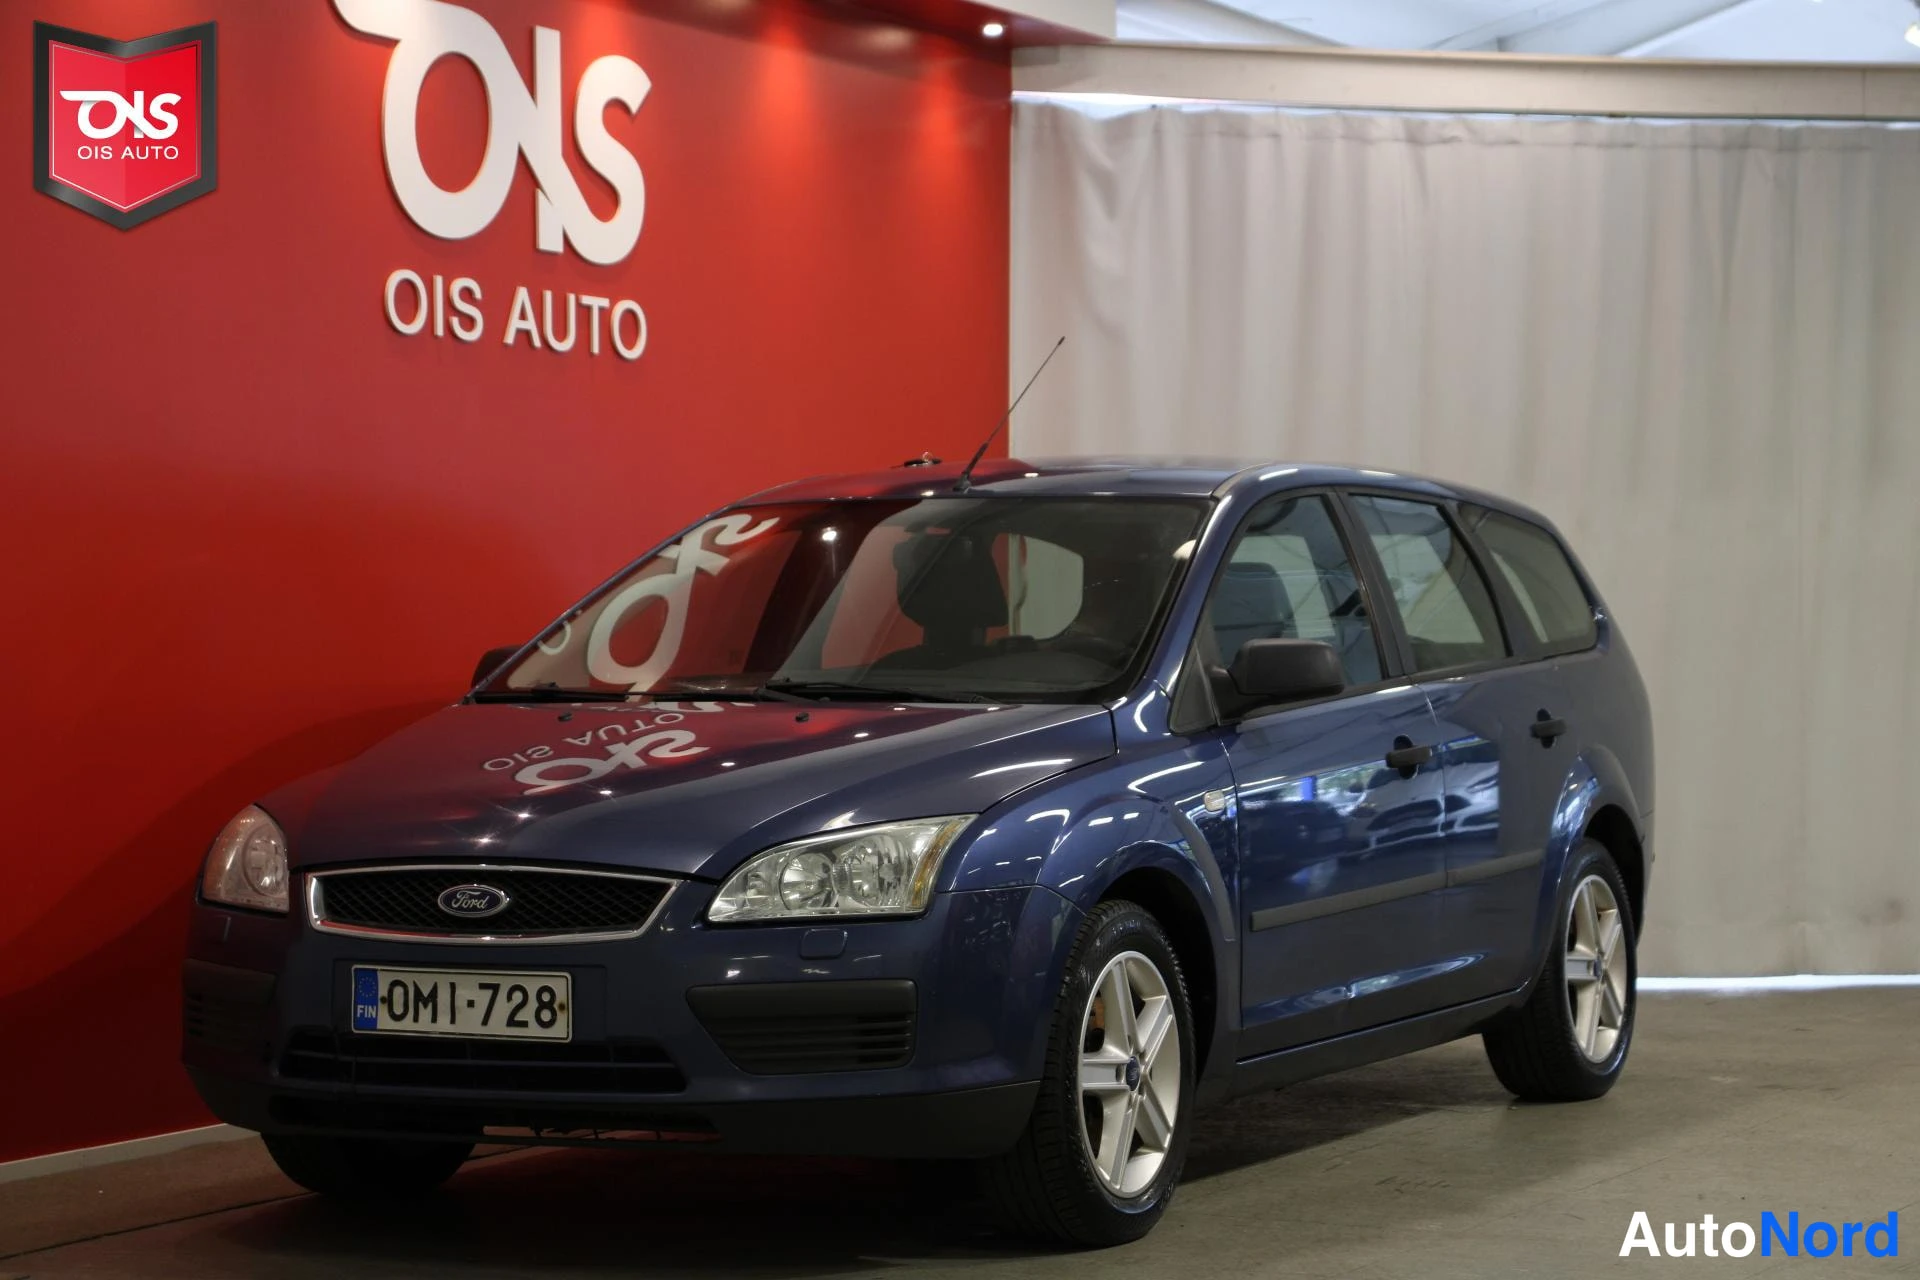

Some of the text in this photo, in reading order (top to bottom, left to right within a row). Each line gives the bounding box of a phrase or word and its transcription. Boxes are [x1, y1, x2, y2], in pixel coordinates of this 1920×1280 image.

[384, 269, 647, 360] OIS AUTO
[452, 890, 490, 909] Ford
[357, 1004, 377, 1018] FIN
[387, 979, 558, 1029] OMI-728
